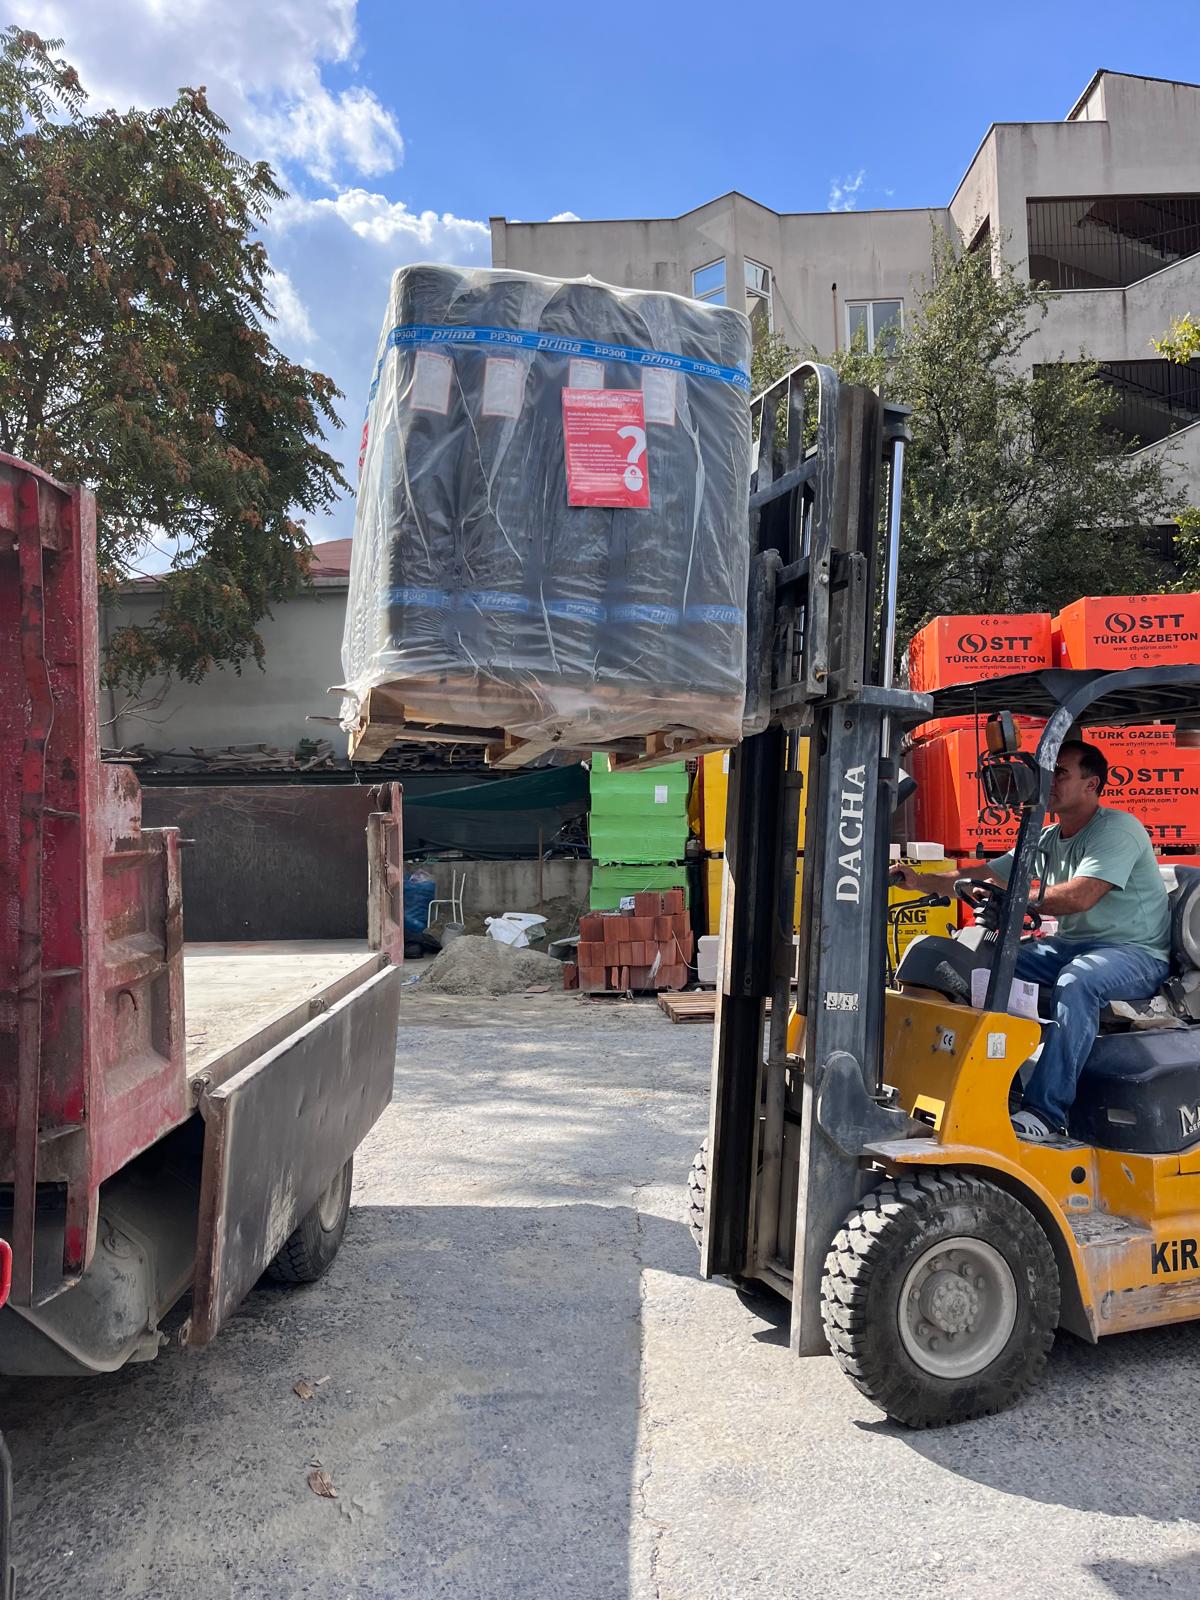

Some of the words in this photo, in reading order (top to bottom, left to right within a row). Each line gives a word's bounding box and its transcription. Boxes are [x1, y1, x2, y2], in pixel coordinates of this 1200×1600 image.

[431, 330, 476, 341] prima
[490, 333, 523, 344] PP300
[537, 337, 581, 353] prima
[595, 346, 626, 358] PP300
[640, 353, 681, 367] prima
[693, 364, 721, 376] PP300
[1139, 614, 1184, 629] STT
[990, 637, 1032, 650] STT
[1093, 635, 1127, 644] TÜRK
[1131, 632, 1198, 643] GAZBETON
[945, 655, 978, 663] TÜRK
[982, 655, 1046, 663] GAZBETON
[1090, 731, 1124, 739] TÜRK
[1137, 768, 1184, 782] STT
[1129, 787, 1198, 796] GAZBETON
[836, 764, 866, 904] DACHA
[967, 828, 1001, 836] TÜRK
[1144, 825, 1186, 838] STT
